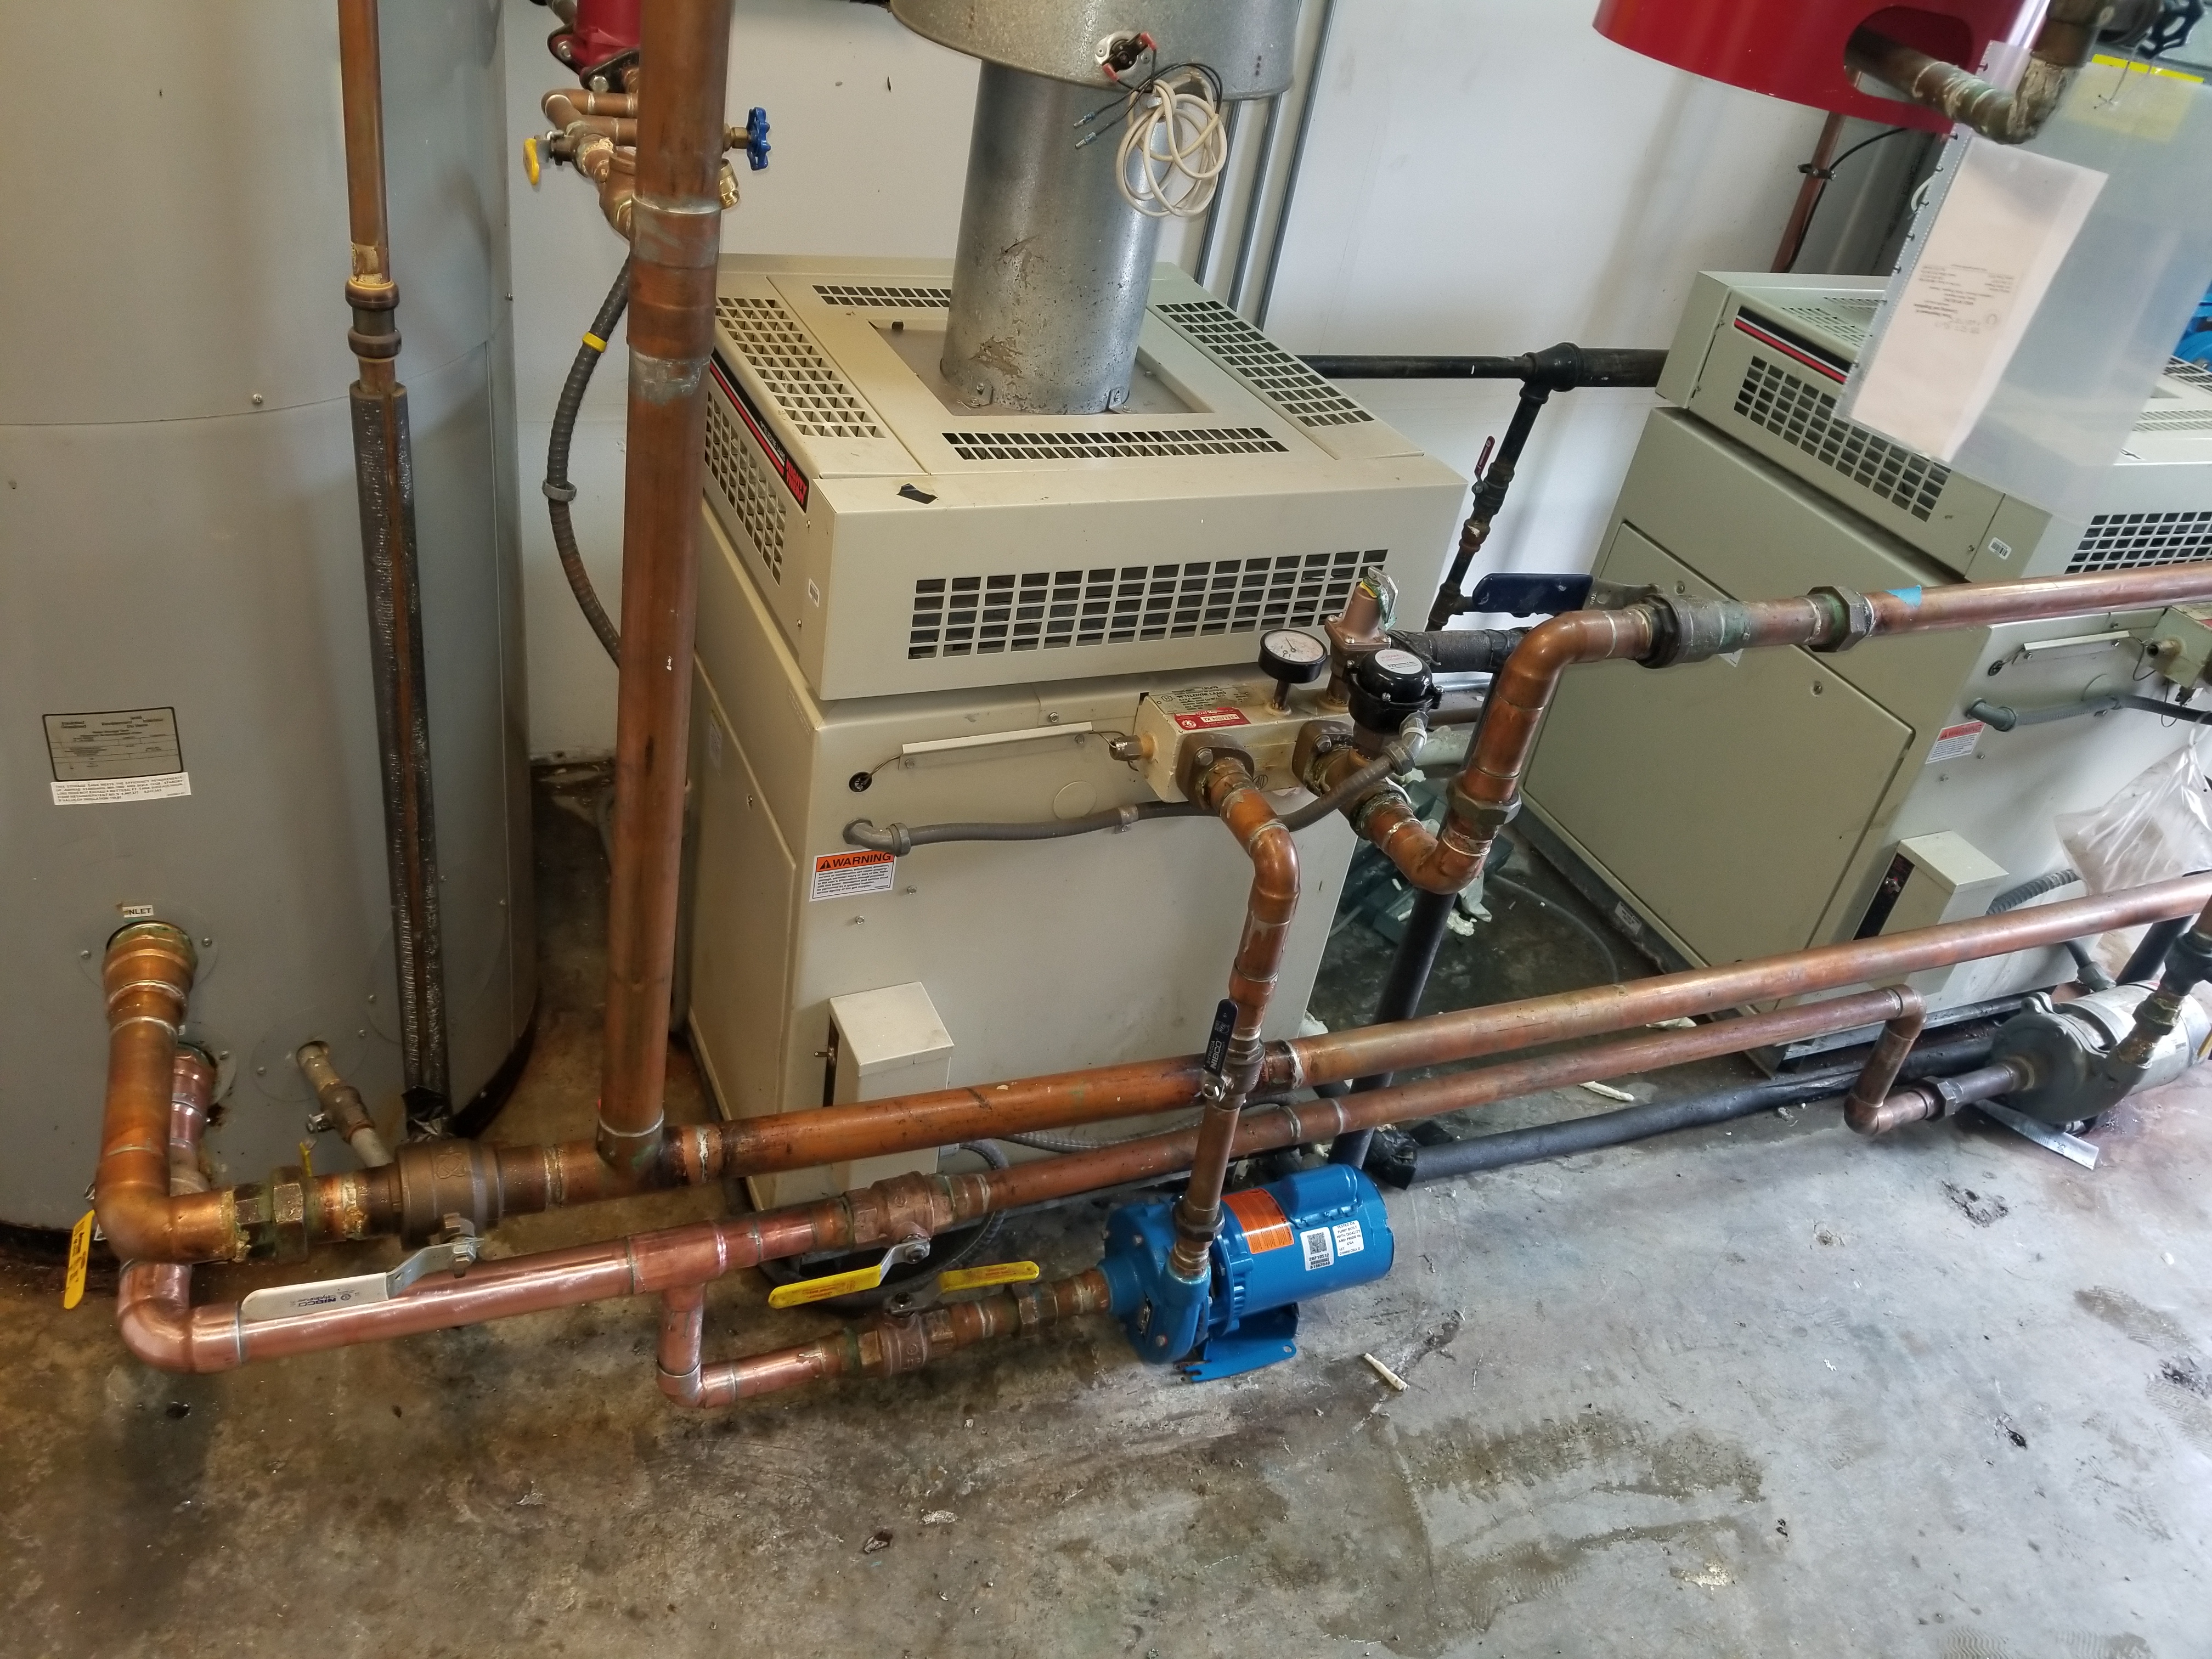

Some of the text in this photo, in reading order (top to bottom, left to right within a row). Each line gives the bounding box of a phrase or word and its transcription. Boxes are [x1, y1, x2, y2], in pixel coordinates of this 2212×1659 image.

[833, 853, 891, 867] WARNING
[1210, 1040, 1222, 1069] NIBCO
[298, 1298, 336, 1306] NIBCO
